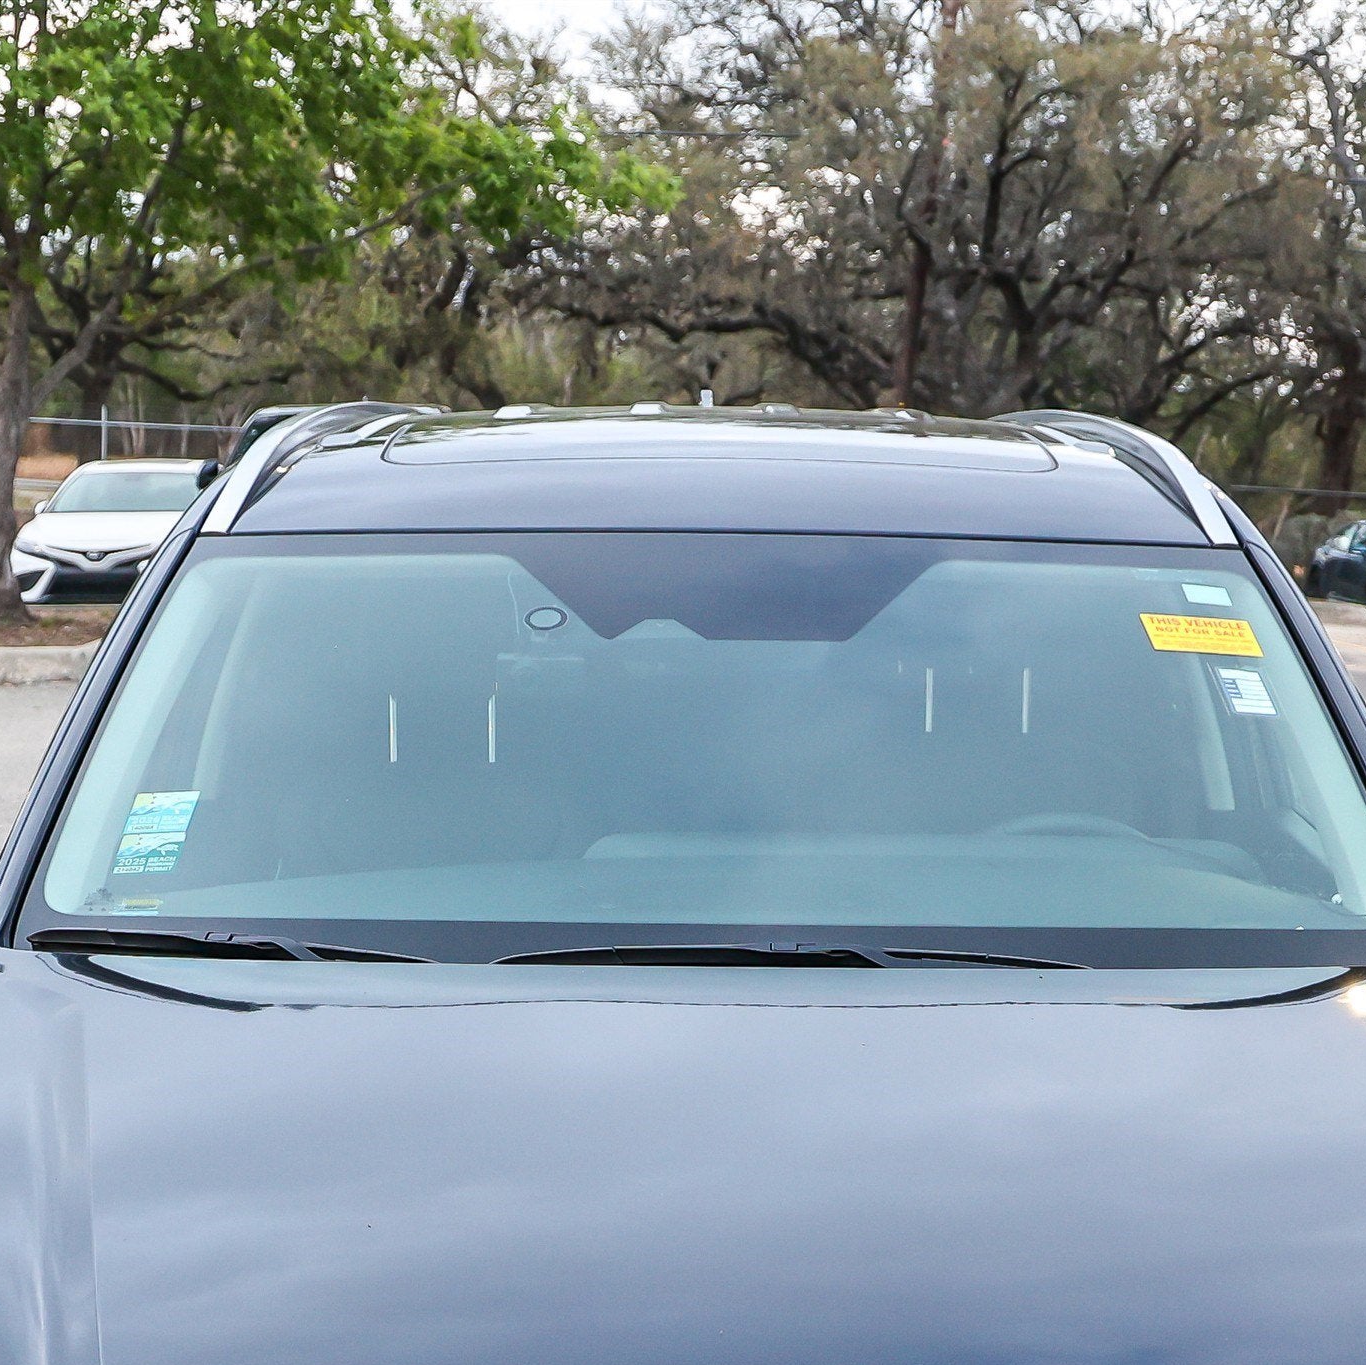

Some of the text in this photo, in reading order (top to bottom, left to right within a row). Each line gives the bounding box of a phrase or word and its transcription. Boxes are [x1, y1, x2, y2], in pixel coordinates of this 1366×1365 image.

[1147, 616, 1246, 631] THIS VEHICLE
[1185, 627, 1211, 635] FOR
[1214, 629, 1246, 638] SALE
[118, 857, 147, 866] 2025
